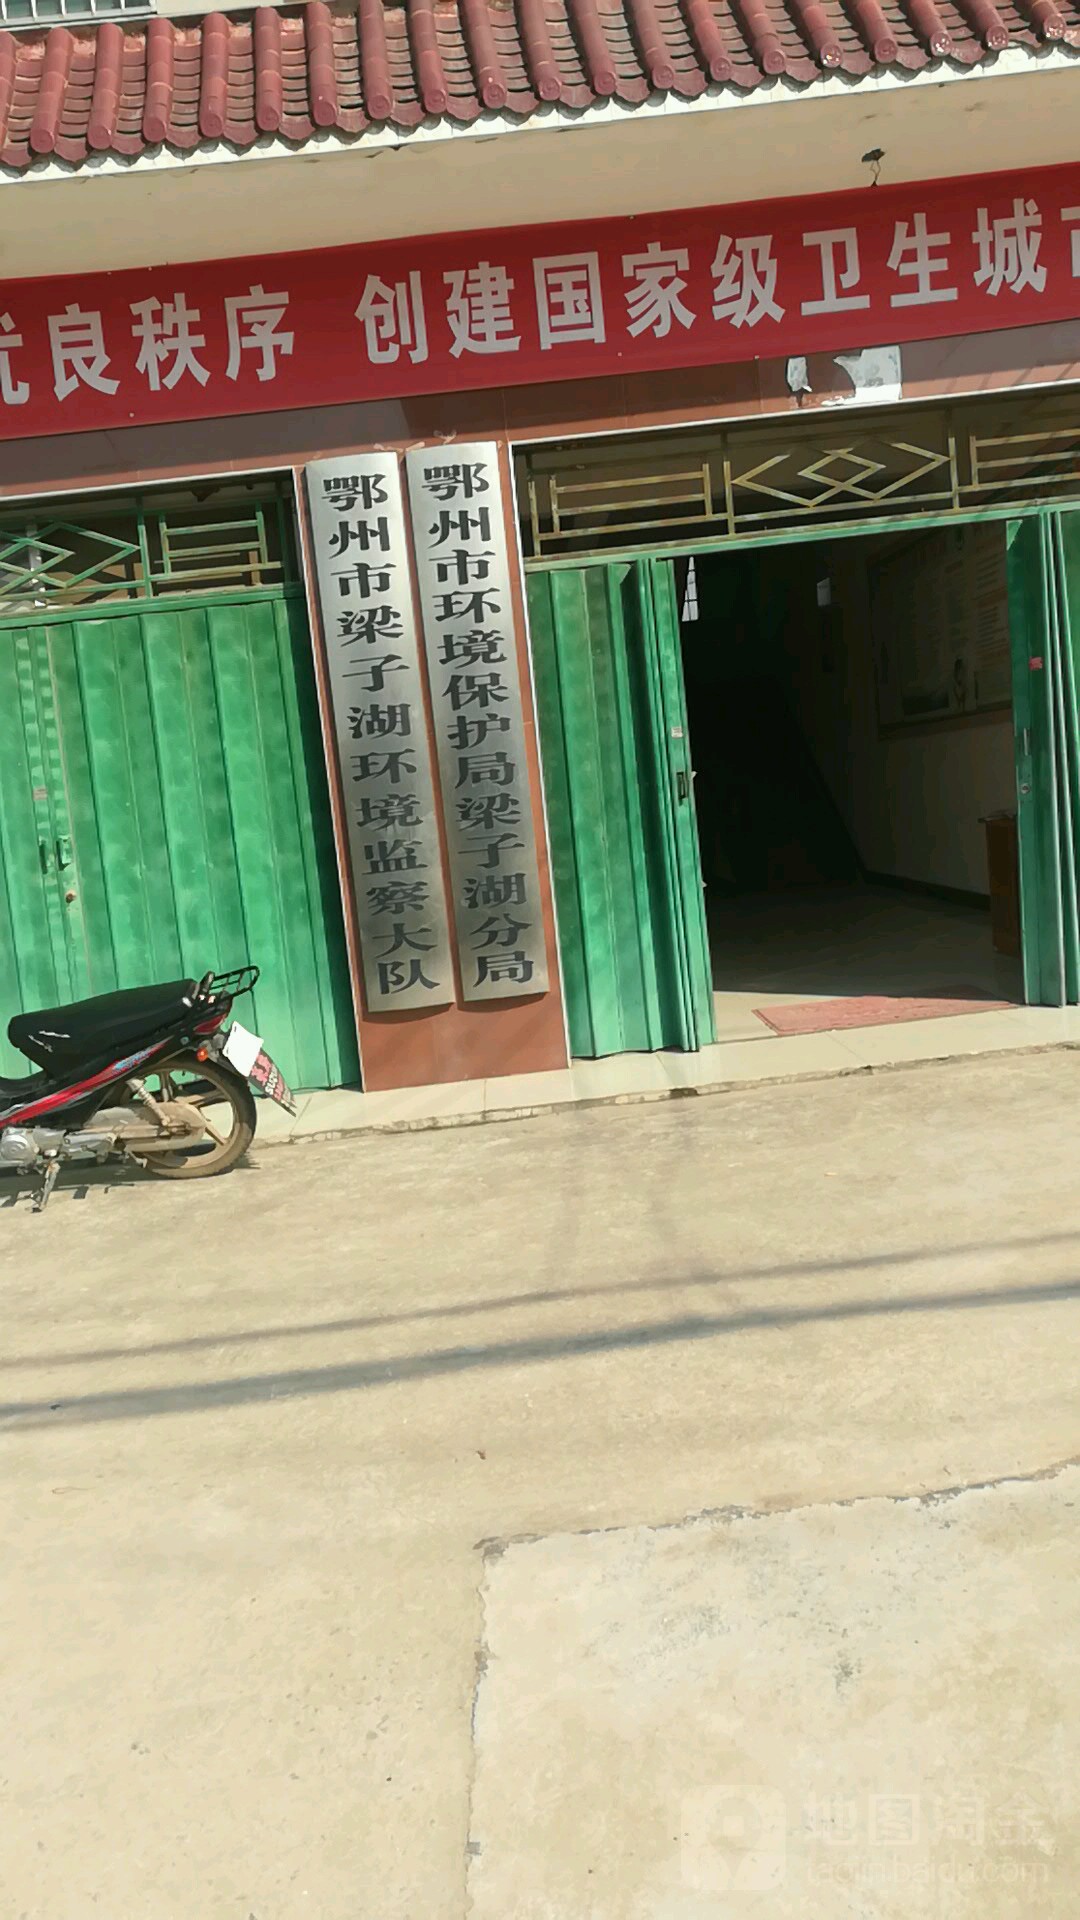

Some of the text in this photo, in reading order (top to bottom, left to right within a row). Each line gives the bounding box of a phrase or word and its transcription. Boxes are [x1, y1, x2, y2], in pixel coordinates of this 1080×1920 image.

[355, 198, 1080, 365] 创建国家级卫生城
[321, 473, 440, 995] 鄂州市梁子湖环境监察大队
[421, 462, 534, 988] 鄂州市环境保护局梁子湖分局
